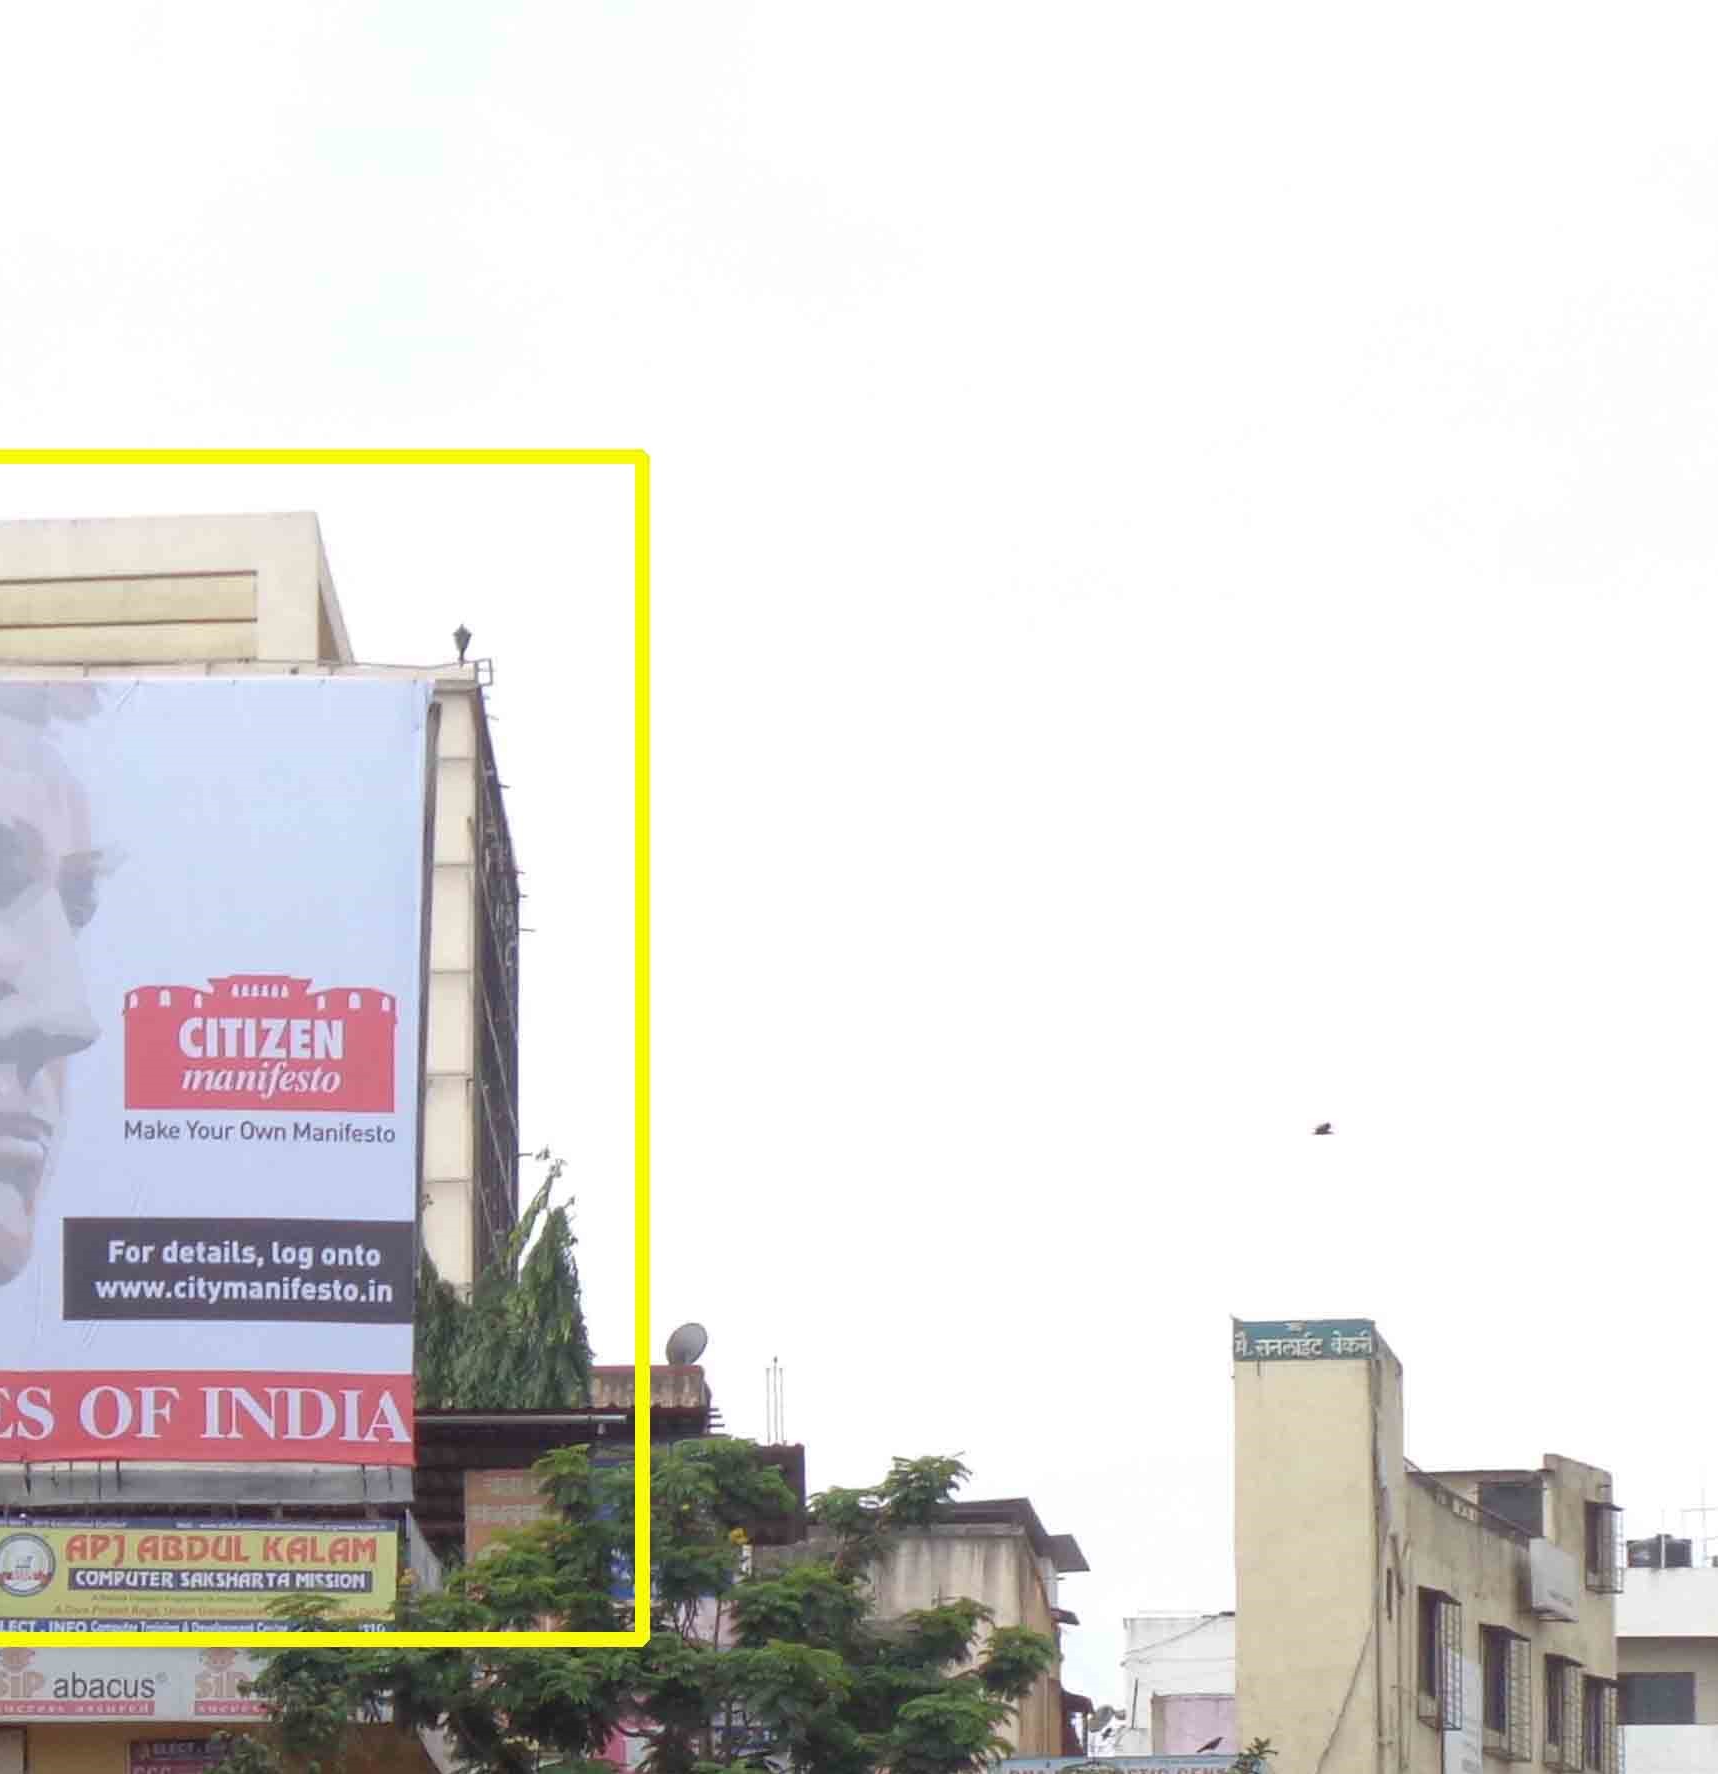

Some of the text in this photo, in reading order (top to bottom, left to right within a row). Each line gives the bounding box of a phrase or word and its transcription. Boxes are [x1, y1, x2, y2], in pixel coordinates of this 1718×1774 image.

[178, 1017, 344, 1060] CITIZEN
[181, 1063, 341, 1099] manifesto
[124, 1120, 396, 1144] Make Your Own Manifesto
[109, 1242, 381, 1271] For details, log onto
[95, 1274, 394, 1307] www.citymanifesto.in
[80, 1386, 180, 1440] OF
[199, 1388, 412, 1444] INDIA
[65, 1535, 377, 1566] APJ ABDUL KALAM
[76, 1571, 366, 1589] COMPUTER SAKSHARTA MISSION
